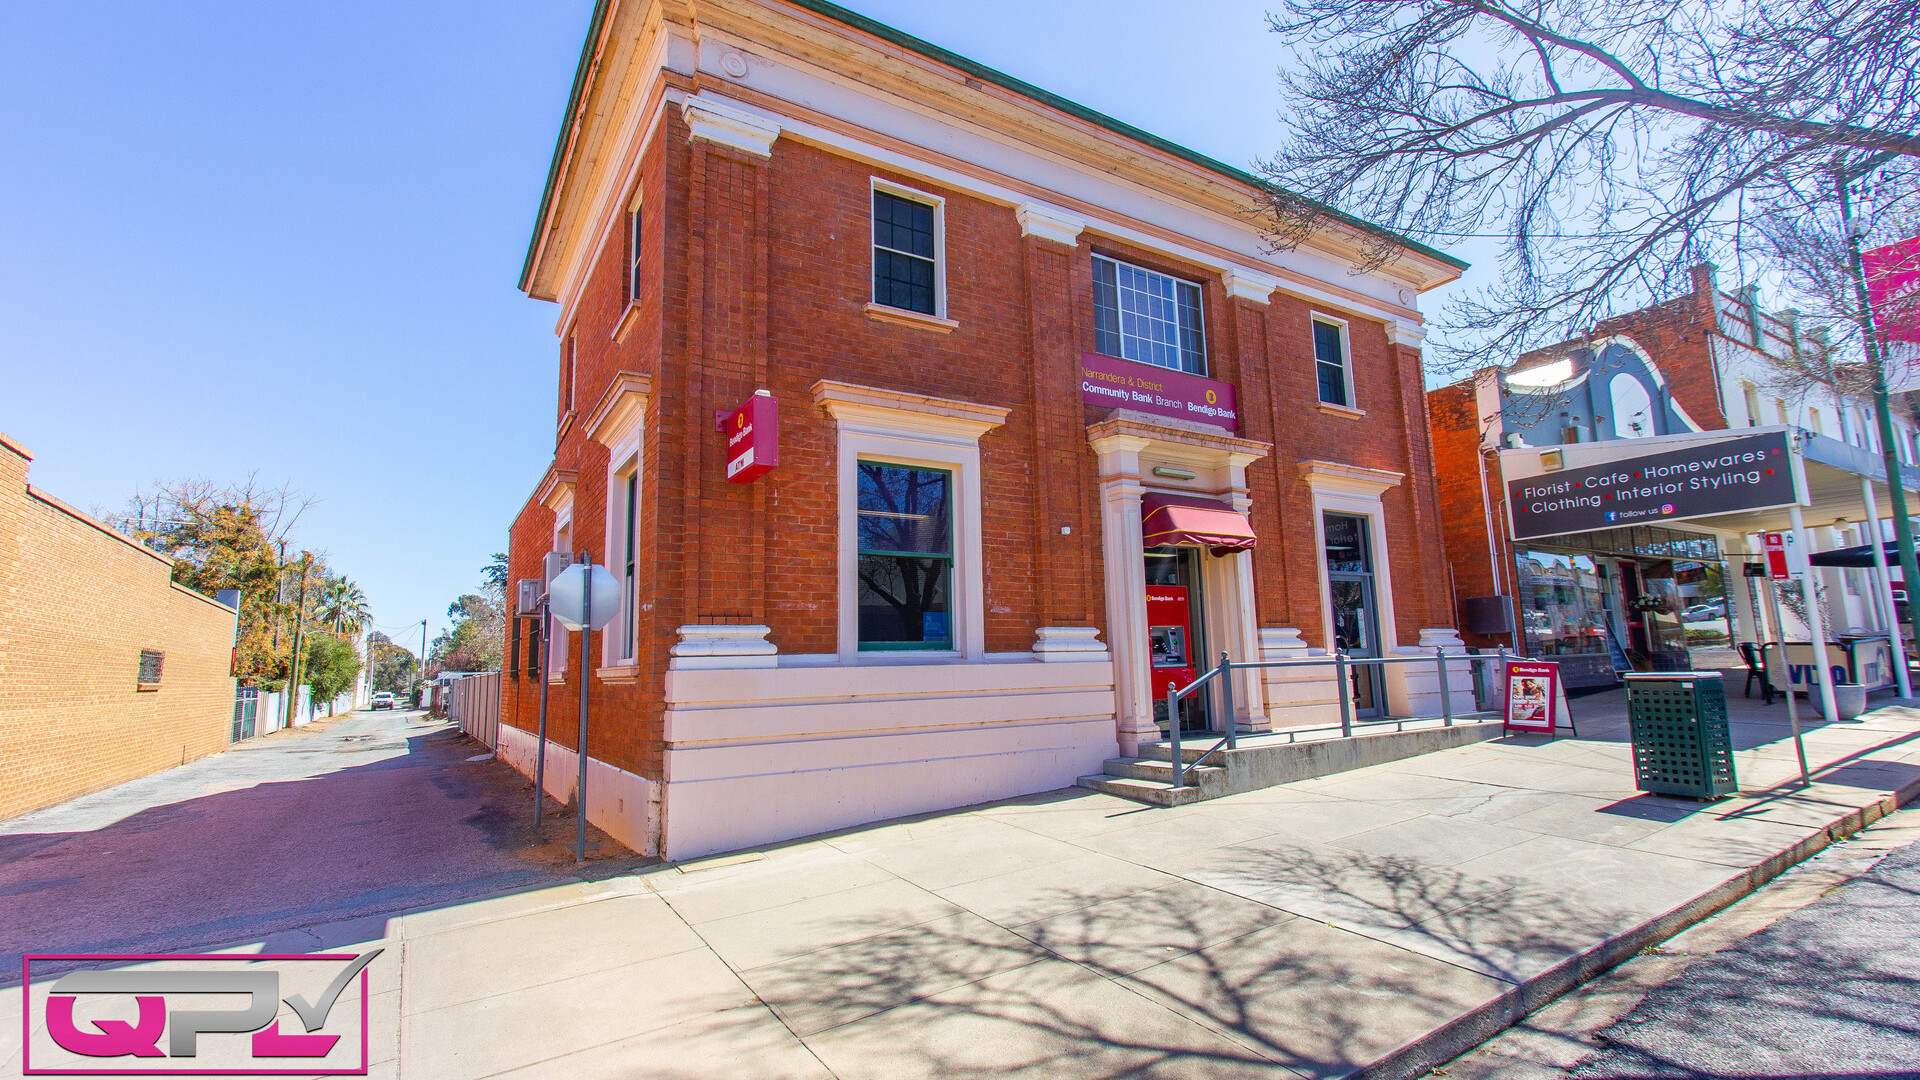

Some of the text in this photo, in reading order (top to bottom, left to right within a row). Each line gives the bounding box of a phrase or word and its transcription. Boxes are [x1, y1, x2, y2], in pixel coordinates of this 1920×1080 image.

[1081, 367, 1163, 392] Narrandera & District
[1082, 382, 1236, 420] Community Bank Branch Bendigo Bank
[1524, 449, 1766, 499] Florist Cafe Homewares
[1531, 469, 1761, 514] Clothing Interior Styling
[1619, 507, 1659, 519] follow us
